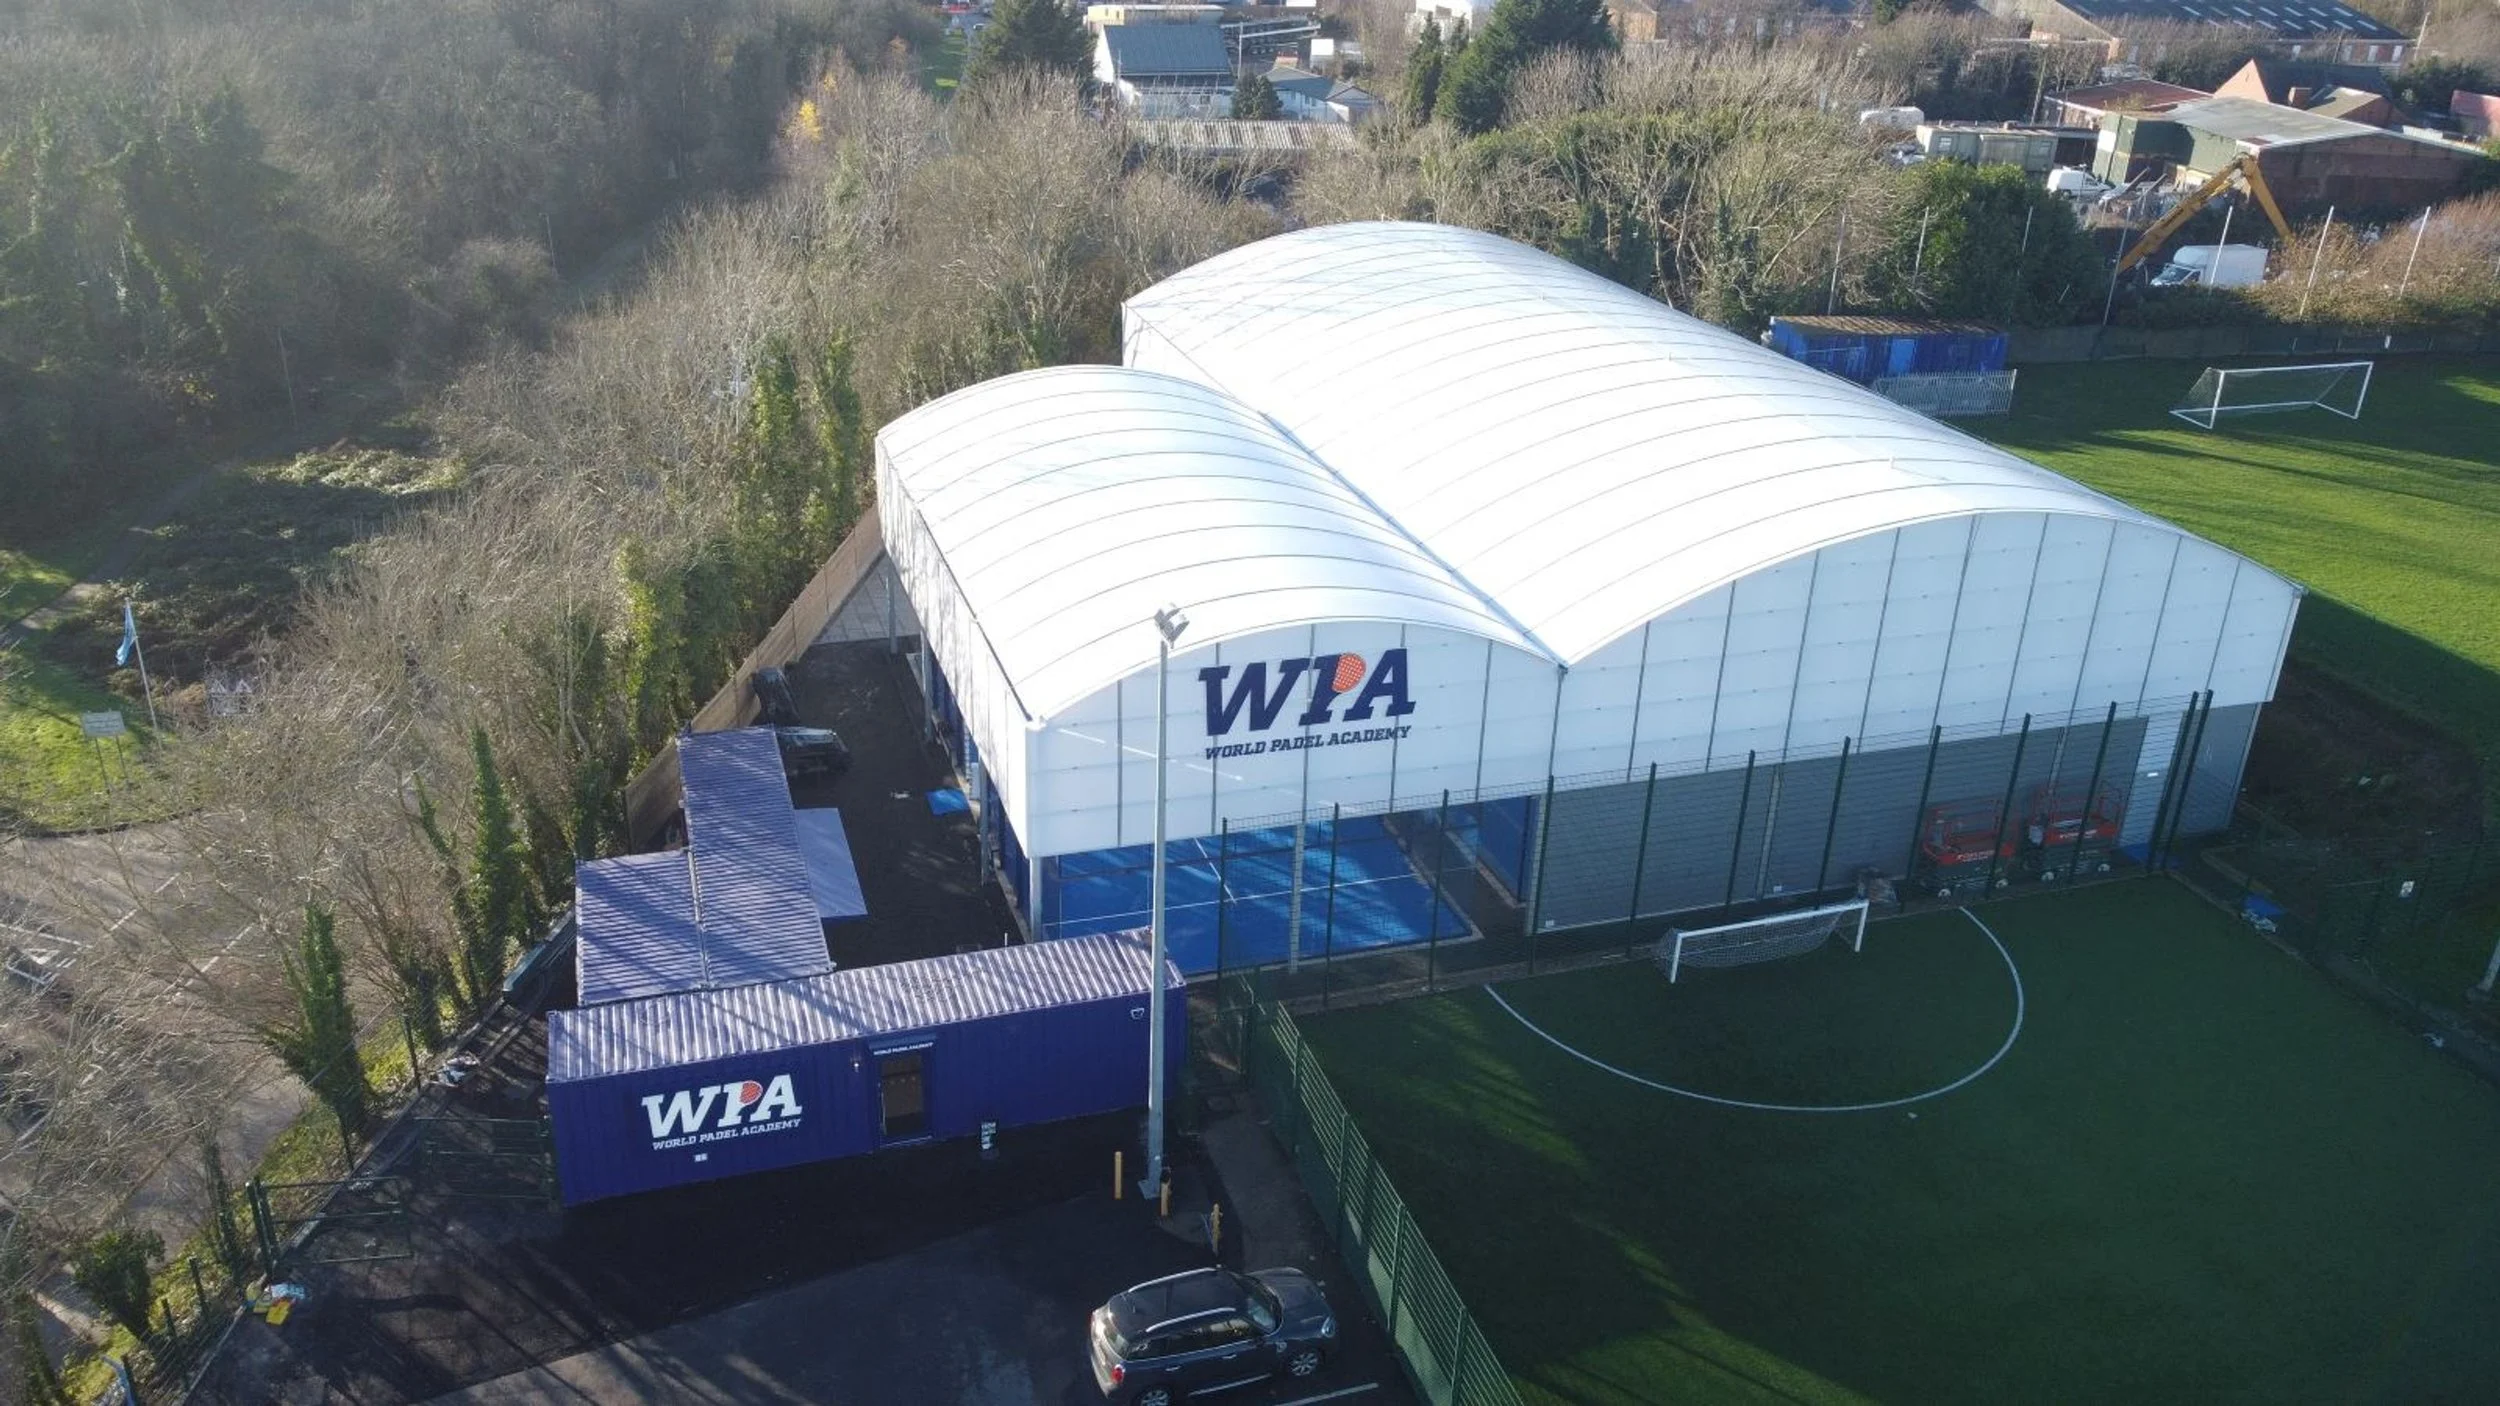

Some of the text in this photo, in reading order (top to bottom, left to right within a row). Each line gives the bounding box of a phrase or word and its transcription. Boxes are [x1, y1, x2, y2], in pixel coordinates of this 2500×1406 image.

[1198, 648, 1416, 736] WPA
[1205, 725, 1411, 760] WORLD PADEL ACADEMY
[641, 1074, 802, 1138] WPA
[652, 1118, 802, 1150] WORLD PADEL ACADEMY
